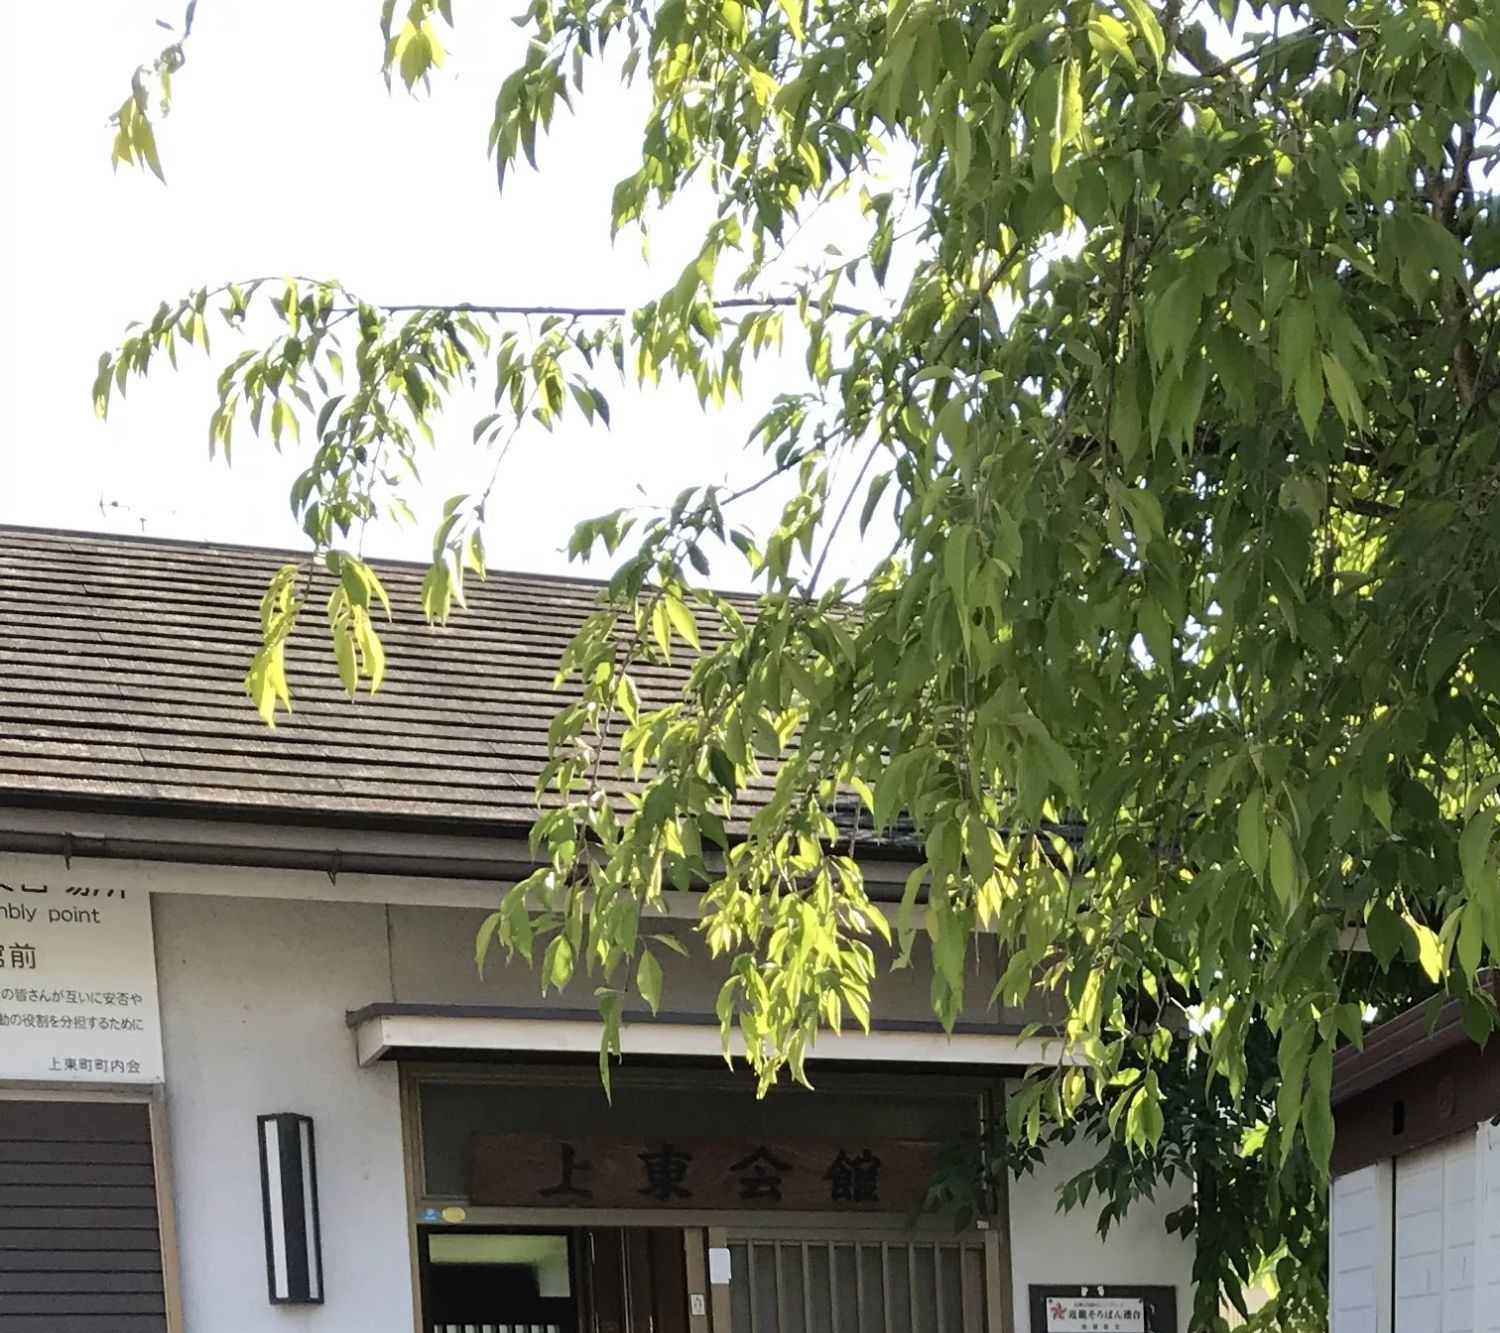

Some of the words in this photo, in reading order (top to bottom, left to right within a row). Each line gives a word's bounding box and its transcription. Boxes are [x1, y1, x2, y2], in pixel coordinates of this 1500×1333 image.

[48, 906, 101, 924] point
[0, 942, 36, 969] 前
[49, 1057, 141, 1074] 上東町町内会
[537, 1143, 882, 1202] 上東会館
